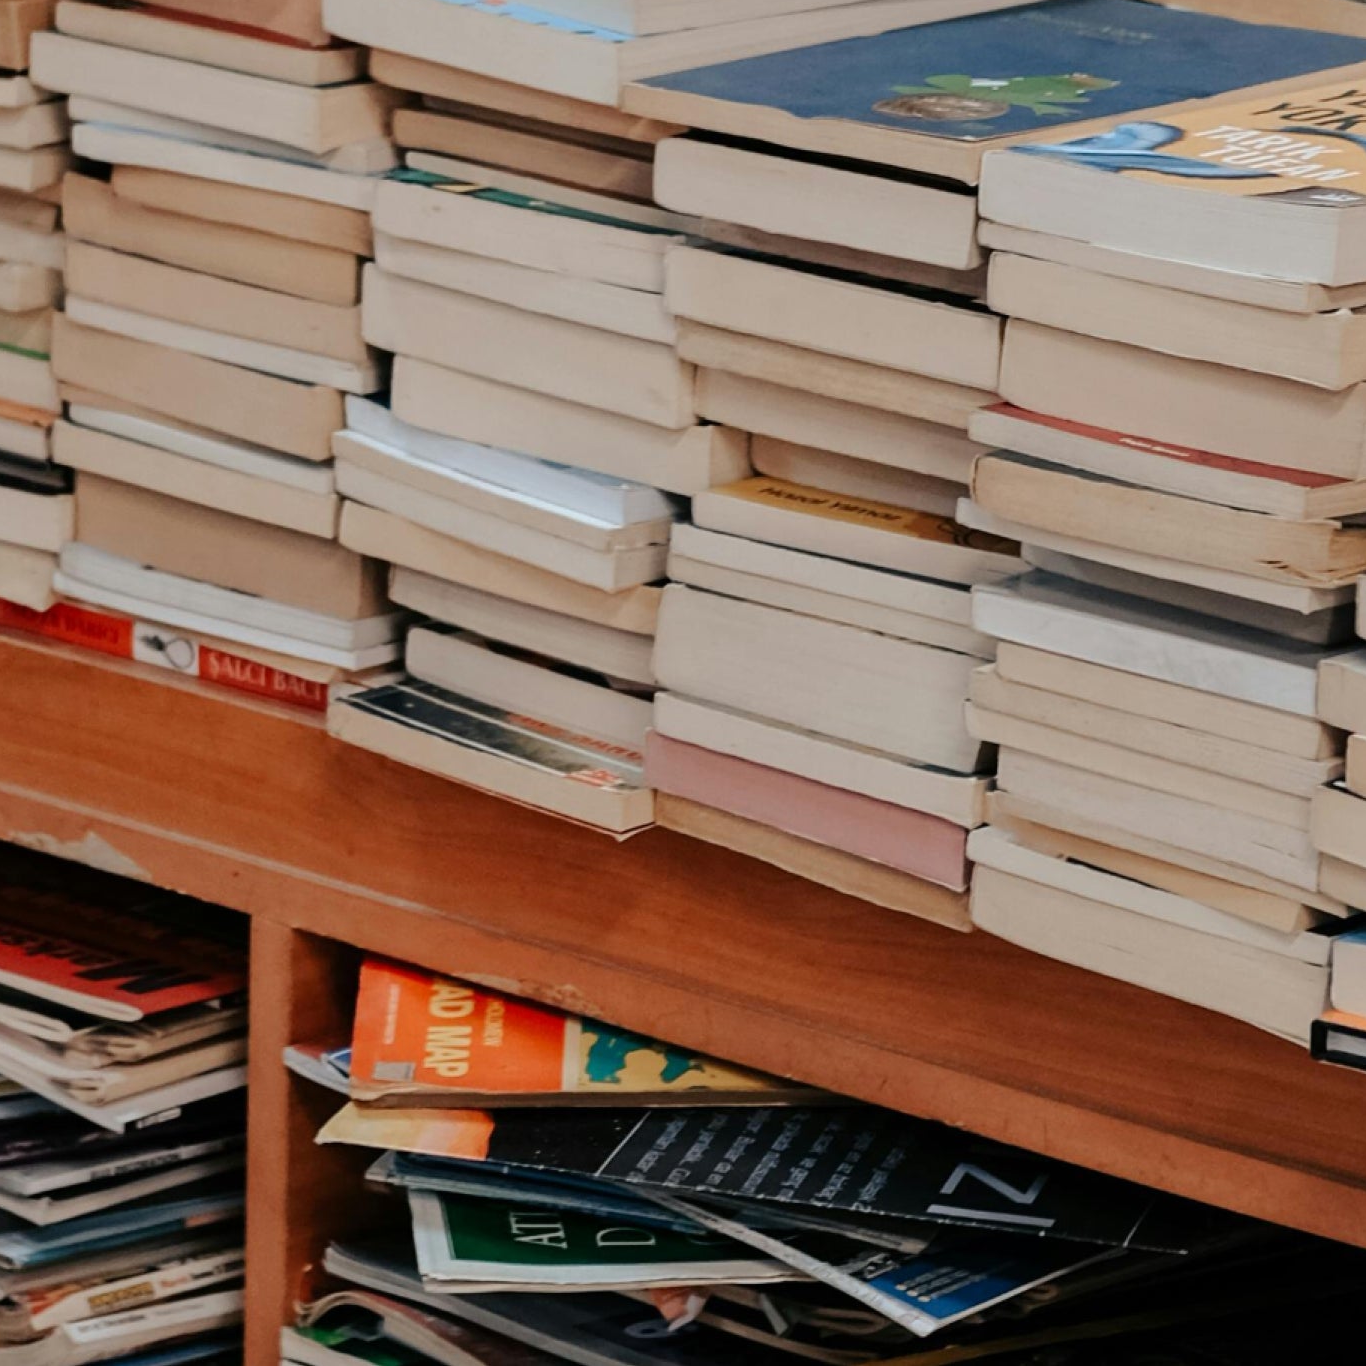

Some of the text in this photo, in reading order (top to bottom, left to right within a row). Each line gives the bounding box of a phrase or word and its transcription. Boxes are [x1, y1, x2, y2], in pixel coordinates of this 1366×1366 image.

[1193, 124, 1344, 161] TARIK
[1199, 144, 1362, 183] TUFAN
[428, 980, 474, 1080] AD MAP
